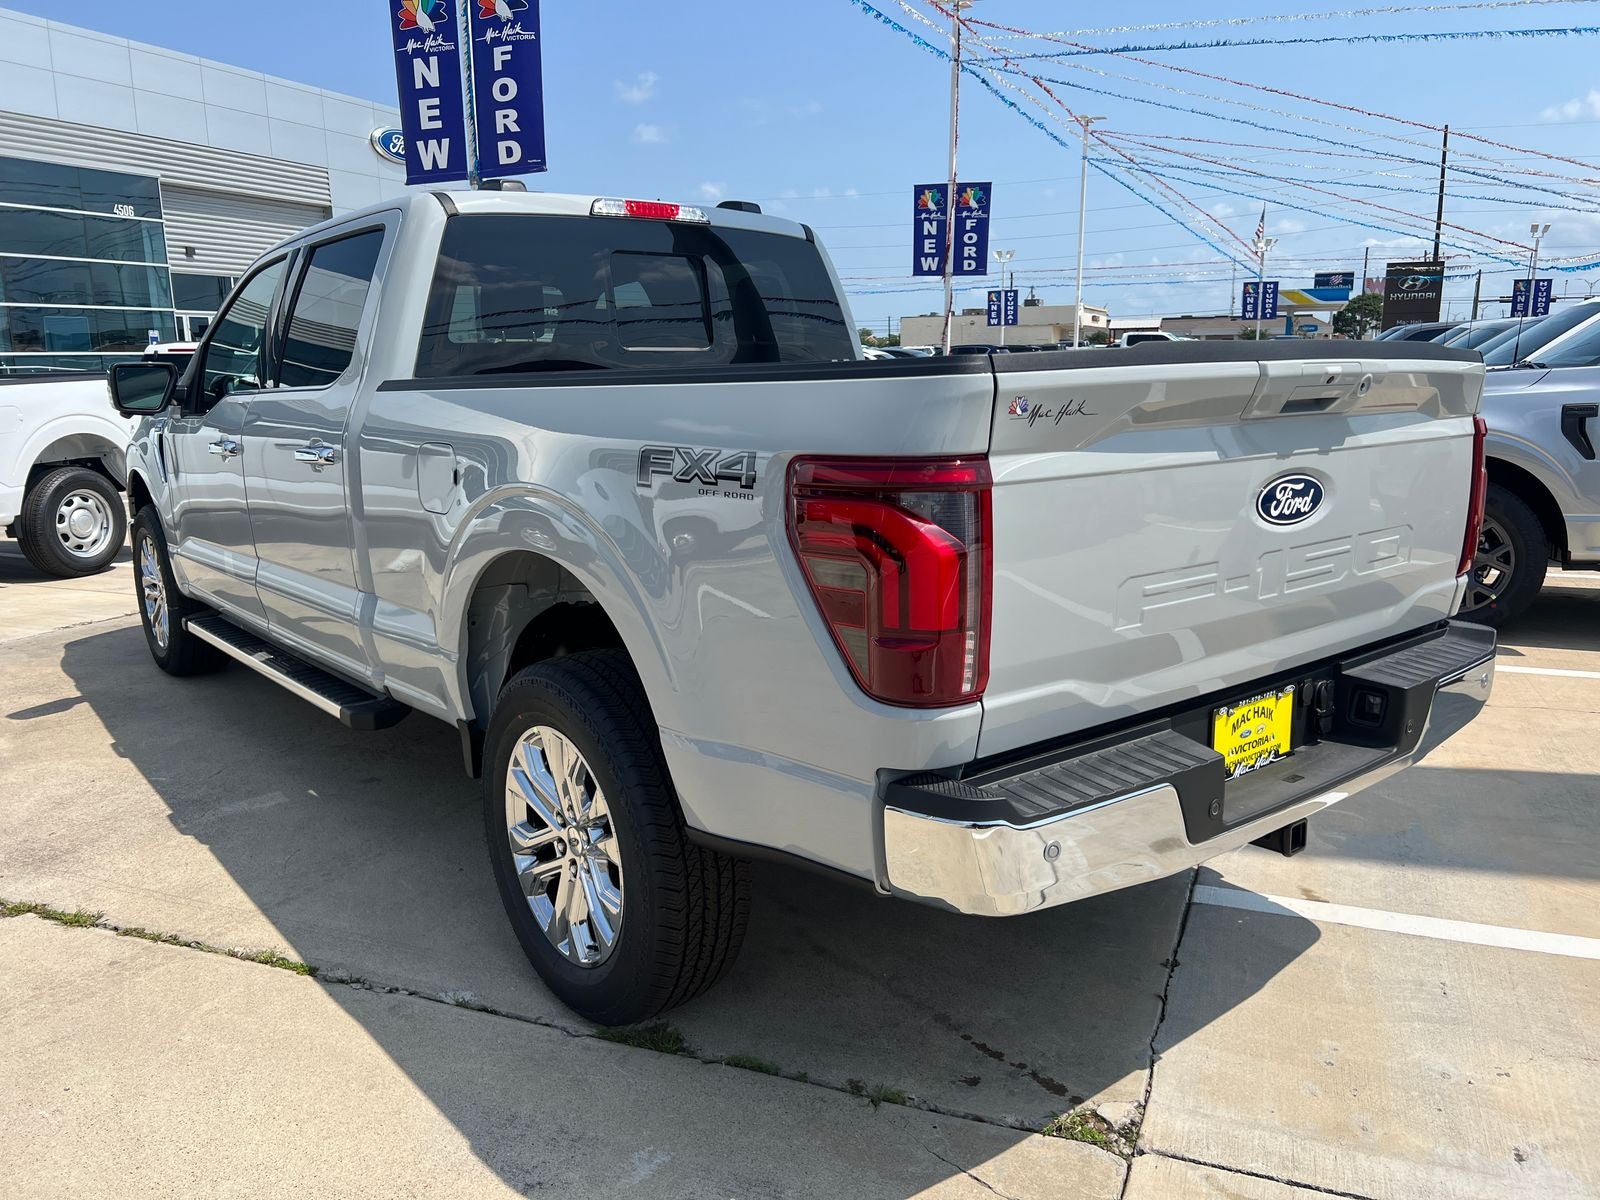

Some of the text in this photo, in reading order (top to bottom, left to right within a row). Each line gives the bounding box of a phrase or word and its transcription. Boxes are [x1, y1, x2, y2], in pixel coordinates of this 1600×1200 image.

[429, 45, 456, 53] VICTORIA
[412, 56, 450, 171] NEW
[492, 45, 522, 165] FORD
[113, 203, 135, 217] 4506
[920, 221, 939, 271] NEW
[963, 219, 978, 271] FORD
[1245, 297, 1254, 319] NEW
[1265, 283, 1274, 318] HYUNDAI
[1389, 292, 1436, 301] HYUNDAI
[990, 304, 998, 325] NEW
[1010, 399, 1098, 427] Mac Haik
[637, 444, 757, 490] FX4
[698, 488, 754, 501] OFF ROAD
[1270, 482, 1315, 517] Ford
[1114, 523, 1414, 632] F-150
[1231, 706, 1274, 737] MAC HAIK
[1232, 735, 1269, 755] VICTORIA
